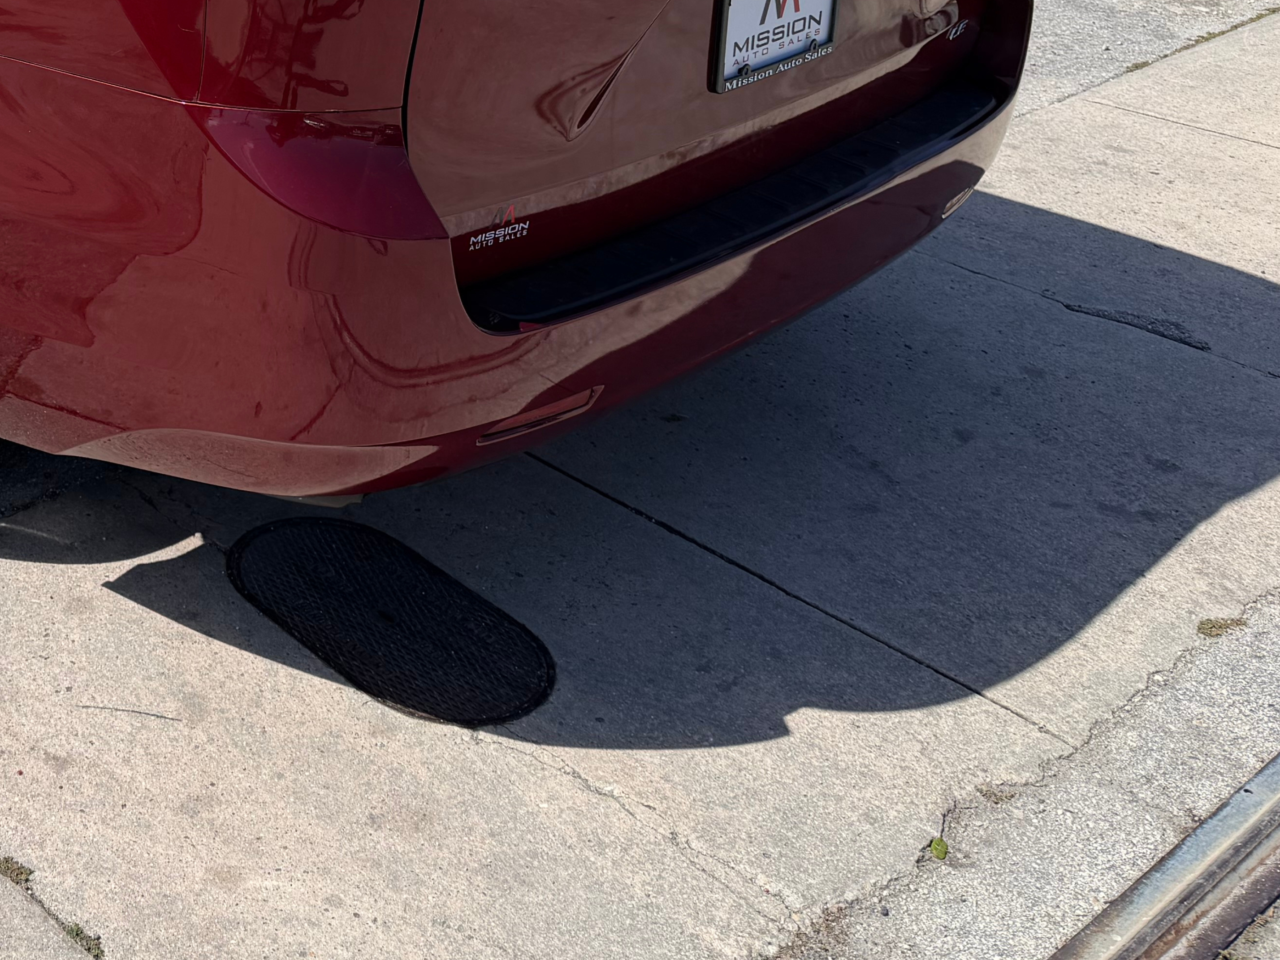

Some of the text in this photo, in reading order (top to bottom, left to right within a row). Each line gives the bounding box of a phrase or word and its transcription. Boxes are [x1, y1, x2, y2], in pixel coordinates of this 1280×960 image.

[732, 10, 823, 58] MISSION
[732, 28, 821, 67] AUTO SALES
[724, 45, 833, 92] Mission Auto Sales
[469, 220, 530, 245] MISSION
[469, 229, 528, 251] AUTO SALES
